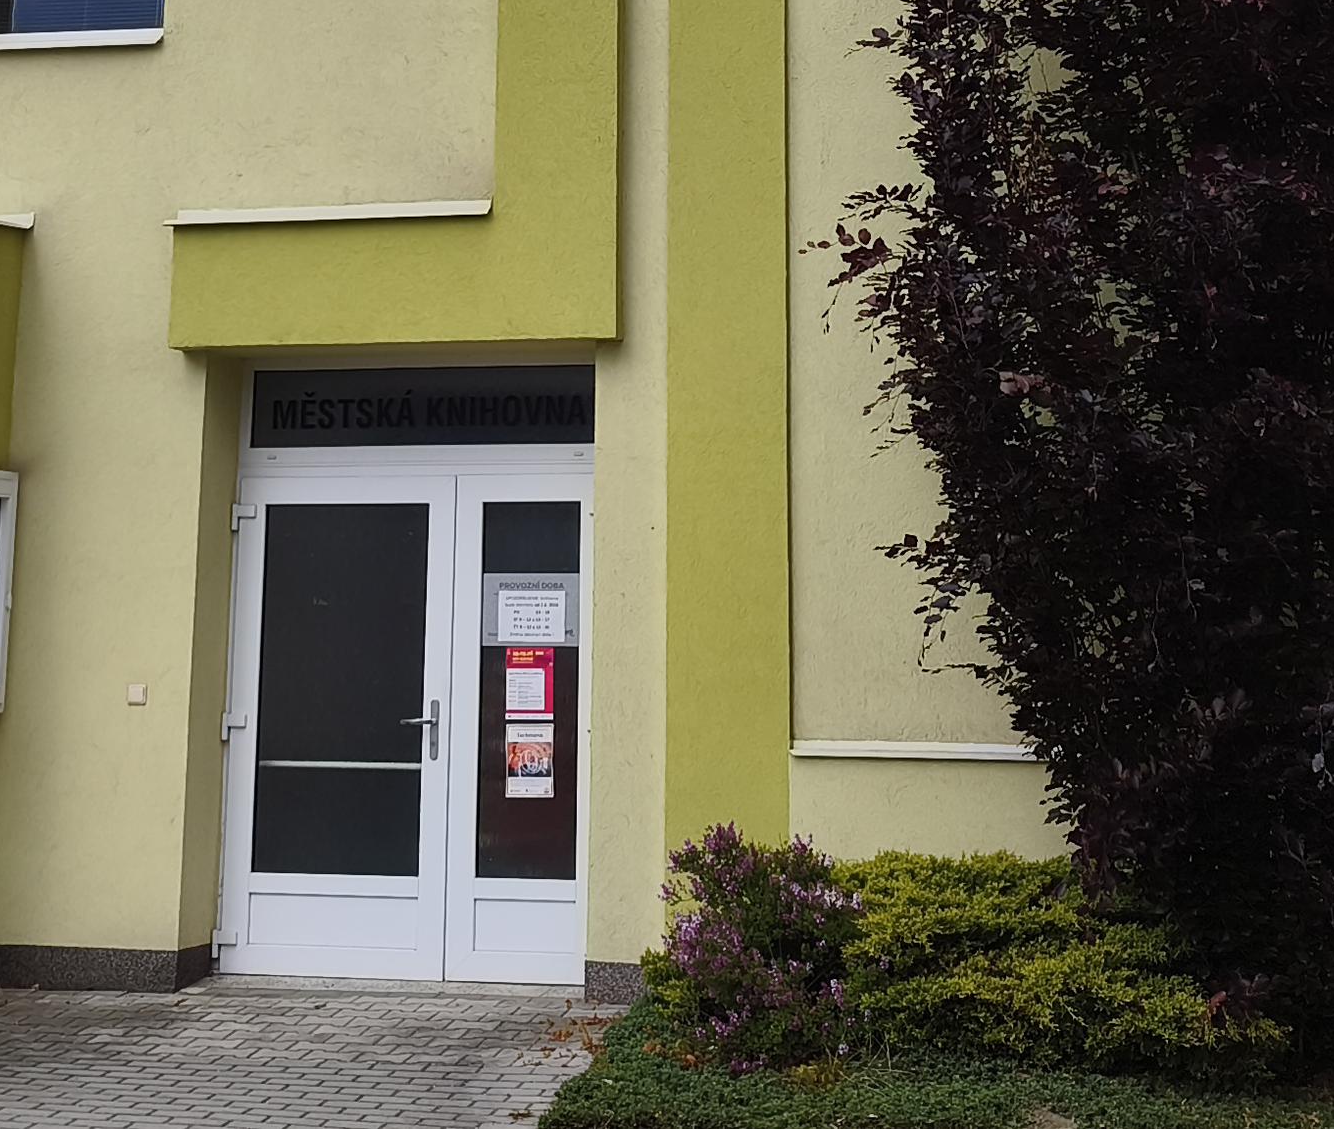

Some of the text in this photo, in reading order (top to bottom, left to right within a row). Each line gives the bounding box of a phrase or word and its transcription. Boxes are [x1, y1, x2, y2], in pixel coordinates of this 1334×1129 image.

[273, 389, 587, 430] MĚSTSKÁ KNIHOVNA
[499, 581, 564, 590] PROVOZNÍ DOBA
